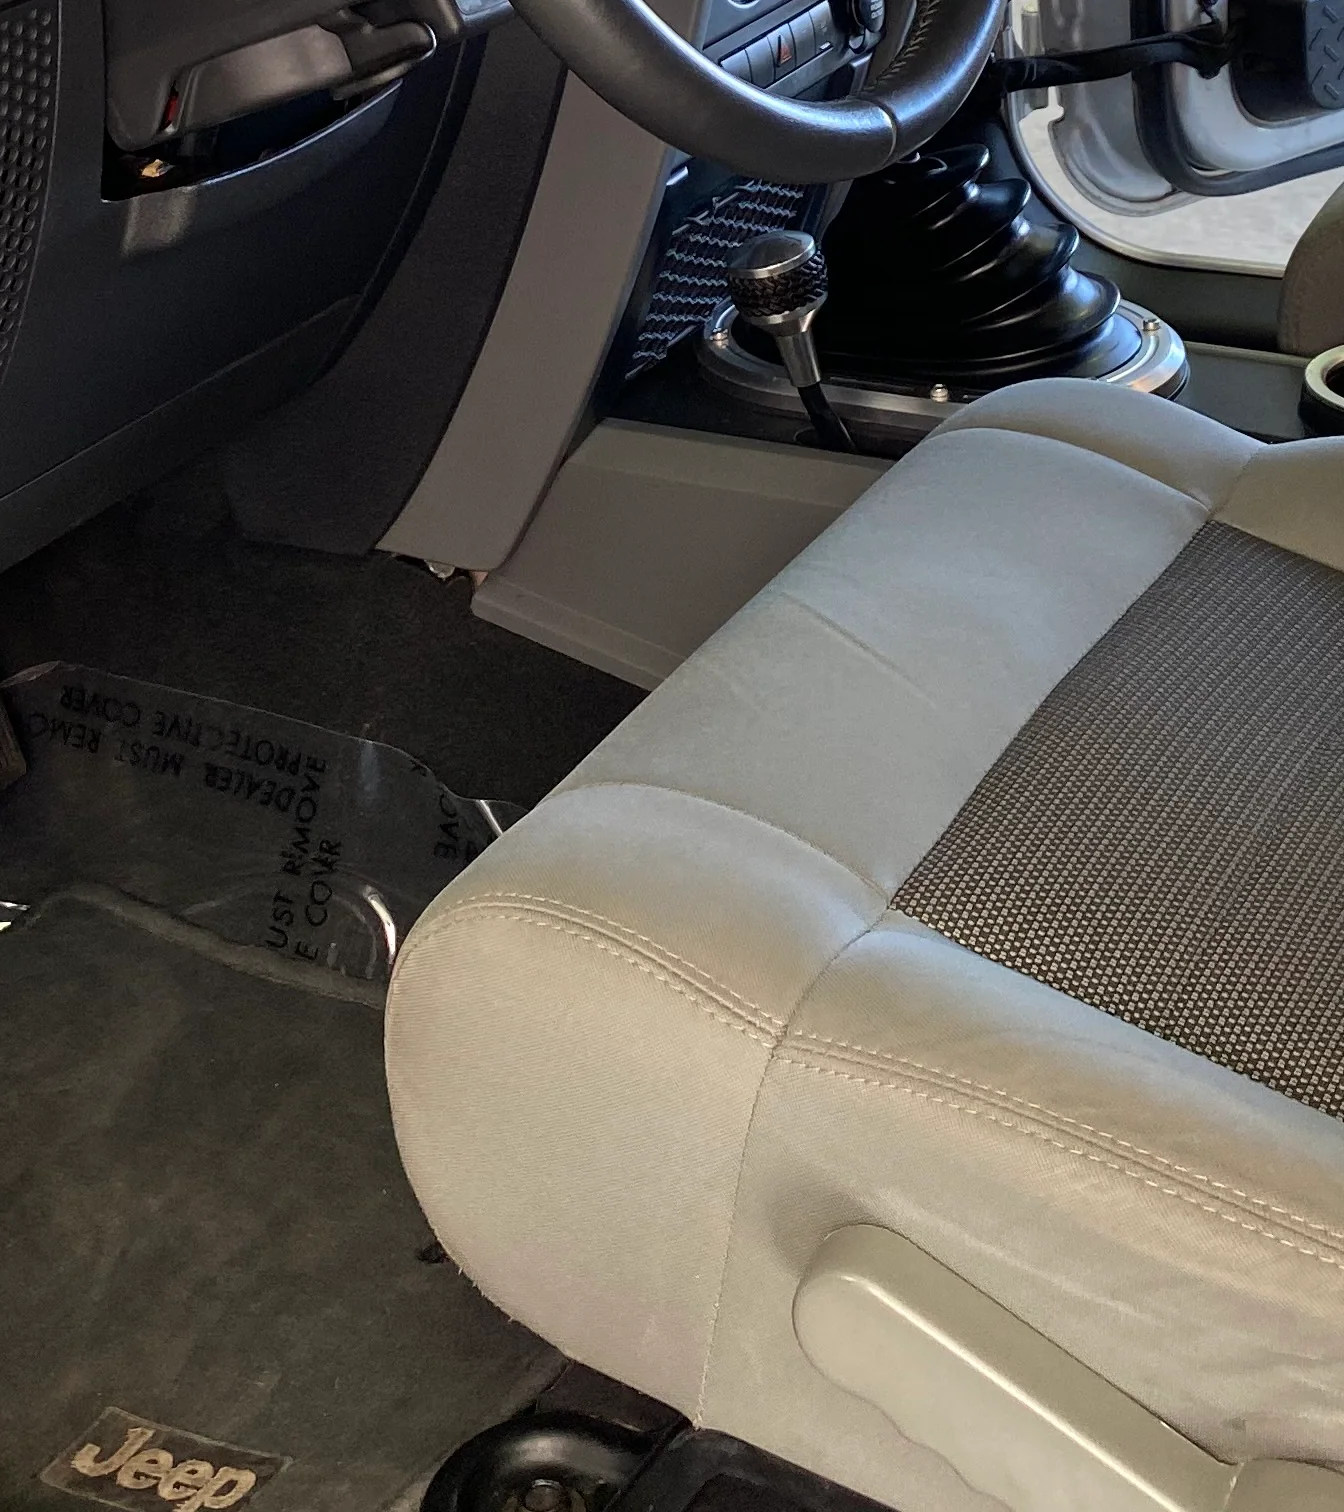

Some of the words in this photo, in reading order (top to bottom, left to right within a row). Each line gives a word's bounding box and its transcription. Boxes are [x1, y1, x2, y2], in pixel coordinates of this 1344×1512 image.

[60, 686, 141, 727] COVER
[114, 739, 185, 777] MUST
[151, 709, 303, 777] PROTECTIVE
[206, 762, 296, 812] DEALER
[70, 1426, 257, 1512] Jeep
